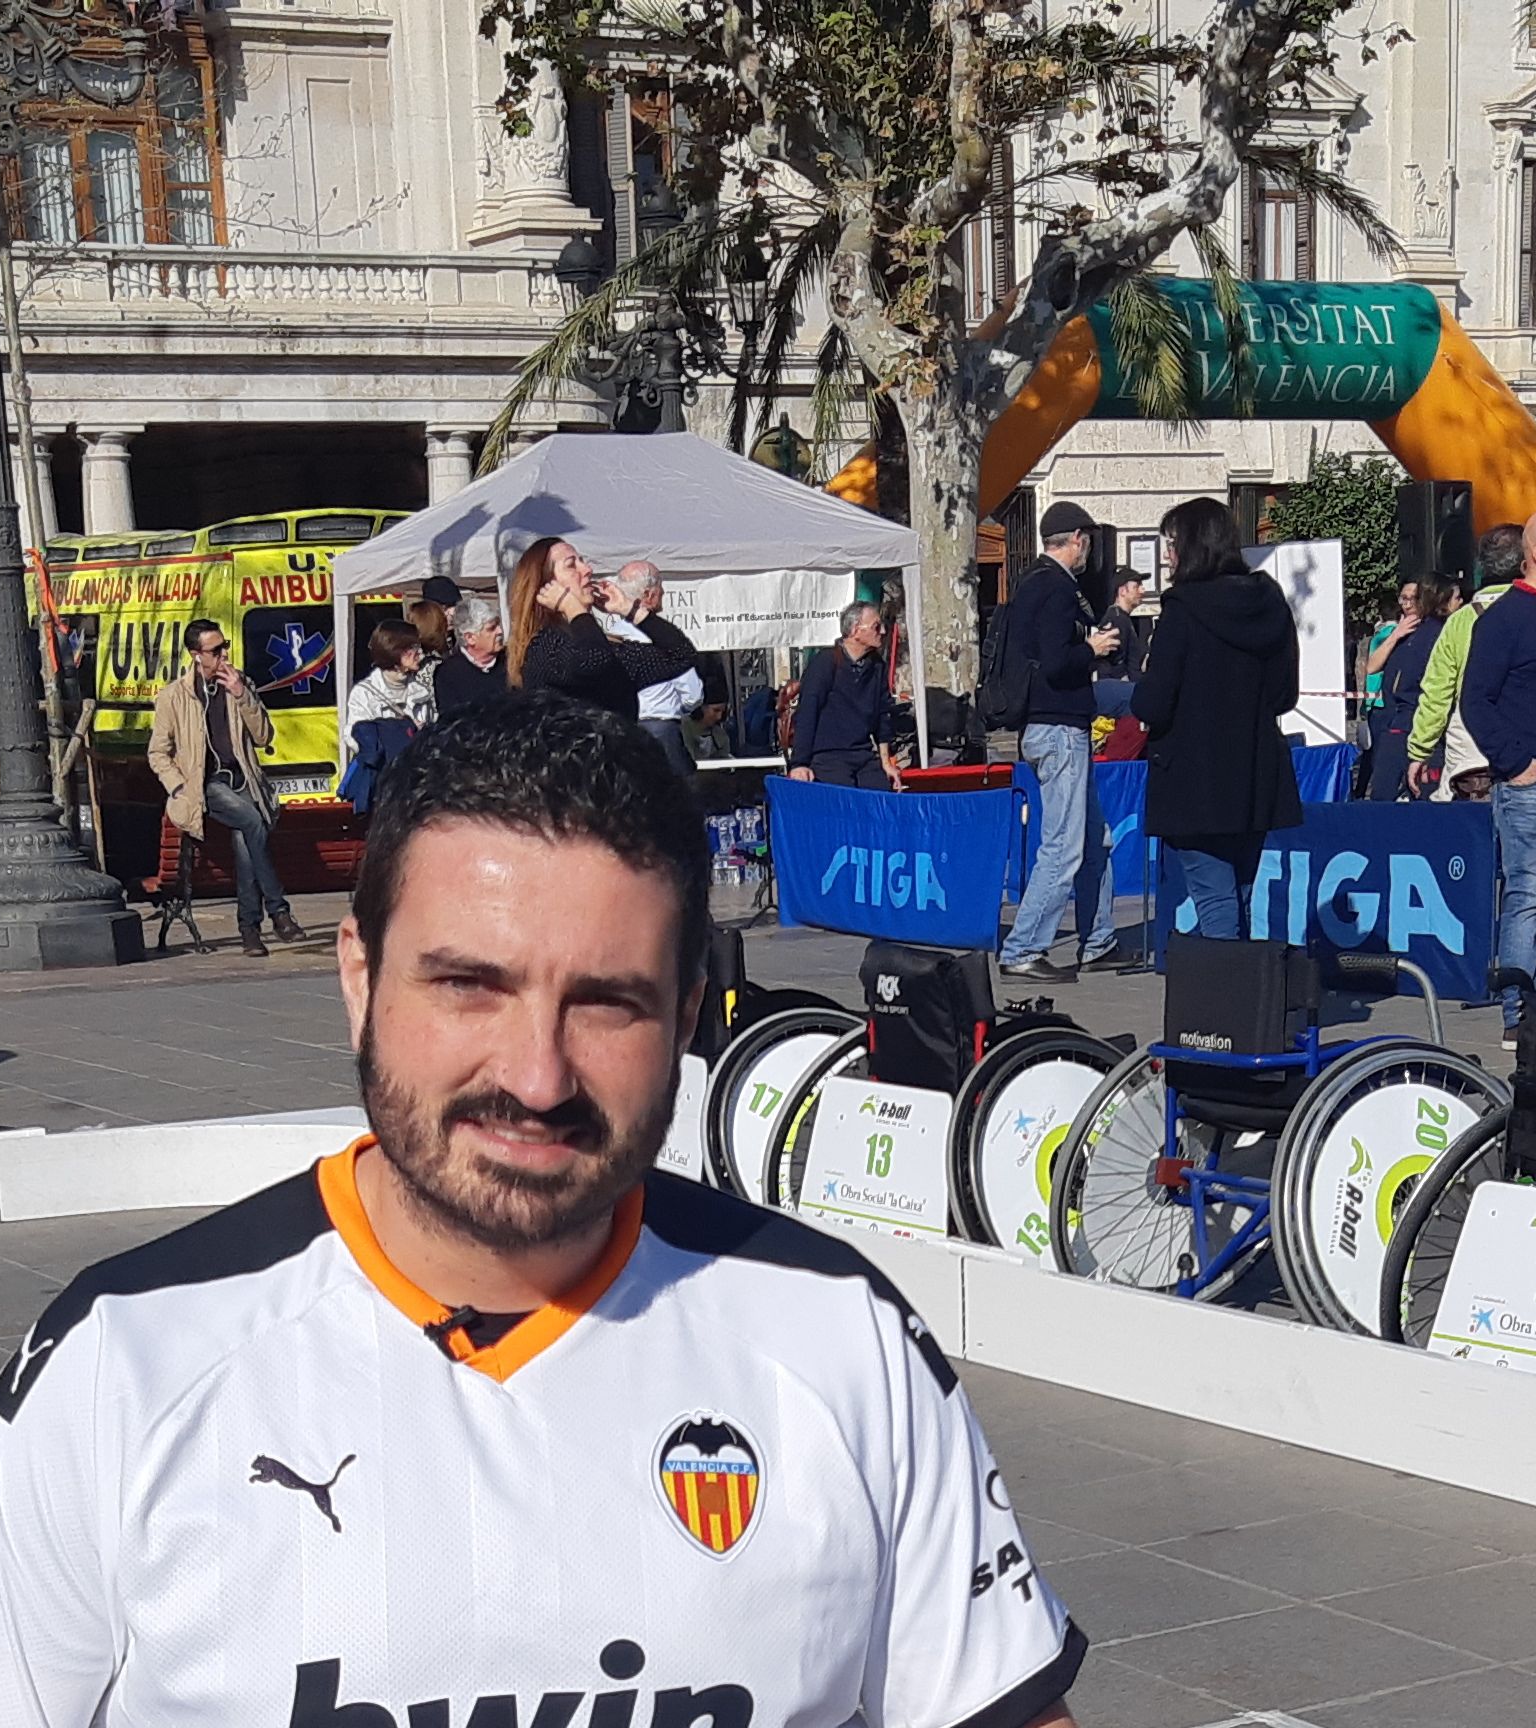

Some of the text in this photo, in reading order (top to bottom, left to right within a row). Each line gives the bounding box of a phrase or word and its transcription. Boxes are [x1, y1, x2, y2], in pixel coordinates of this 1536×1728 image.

[137, 572, 202, 603] VALLADA
[112, 620, 187, 682] U.V.I.
[1179, 1030, 1233, 1052] motivation
[748, 1082, 784, 1120] 17
[1415, 1097, 1450, 1151] 20
[865, 1132, 895, 1179] 13
[1015, 1211, 1050, 1256] 13
[1499, 1313, 1532, 1334] Obra
[667, 1461, 729, 1473] VALENCIA
